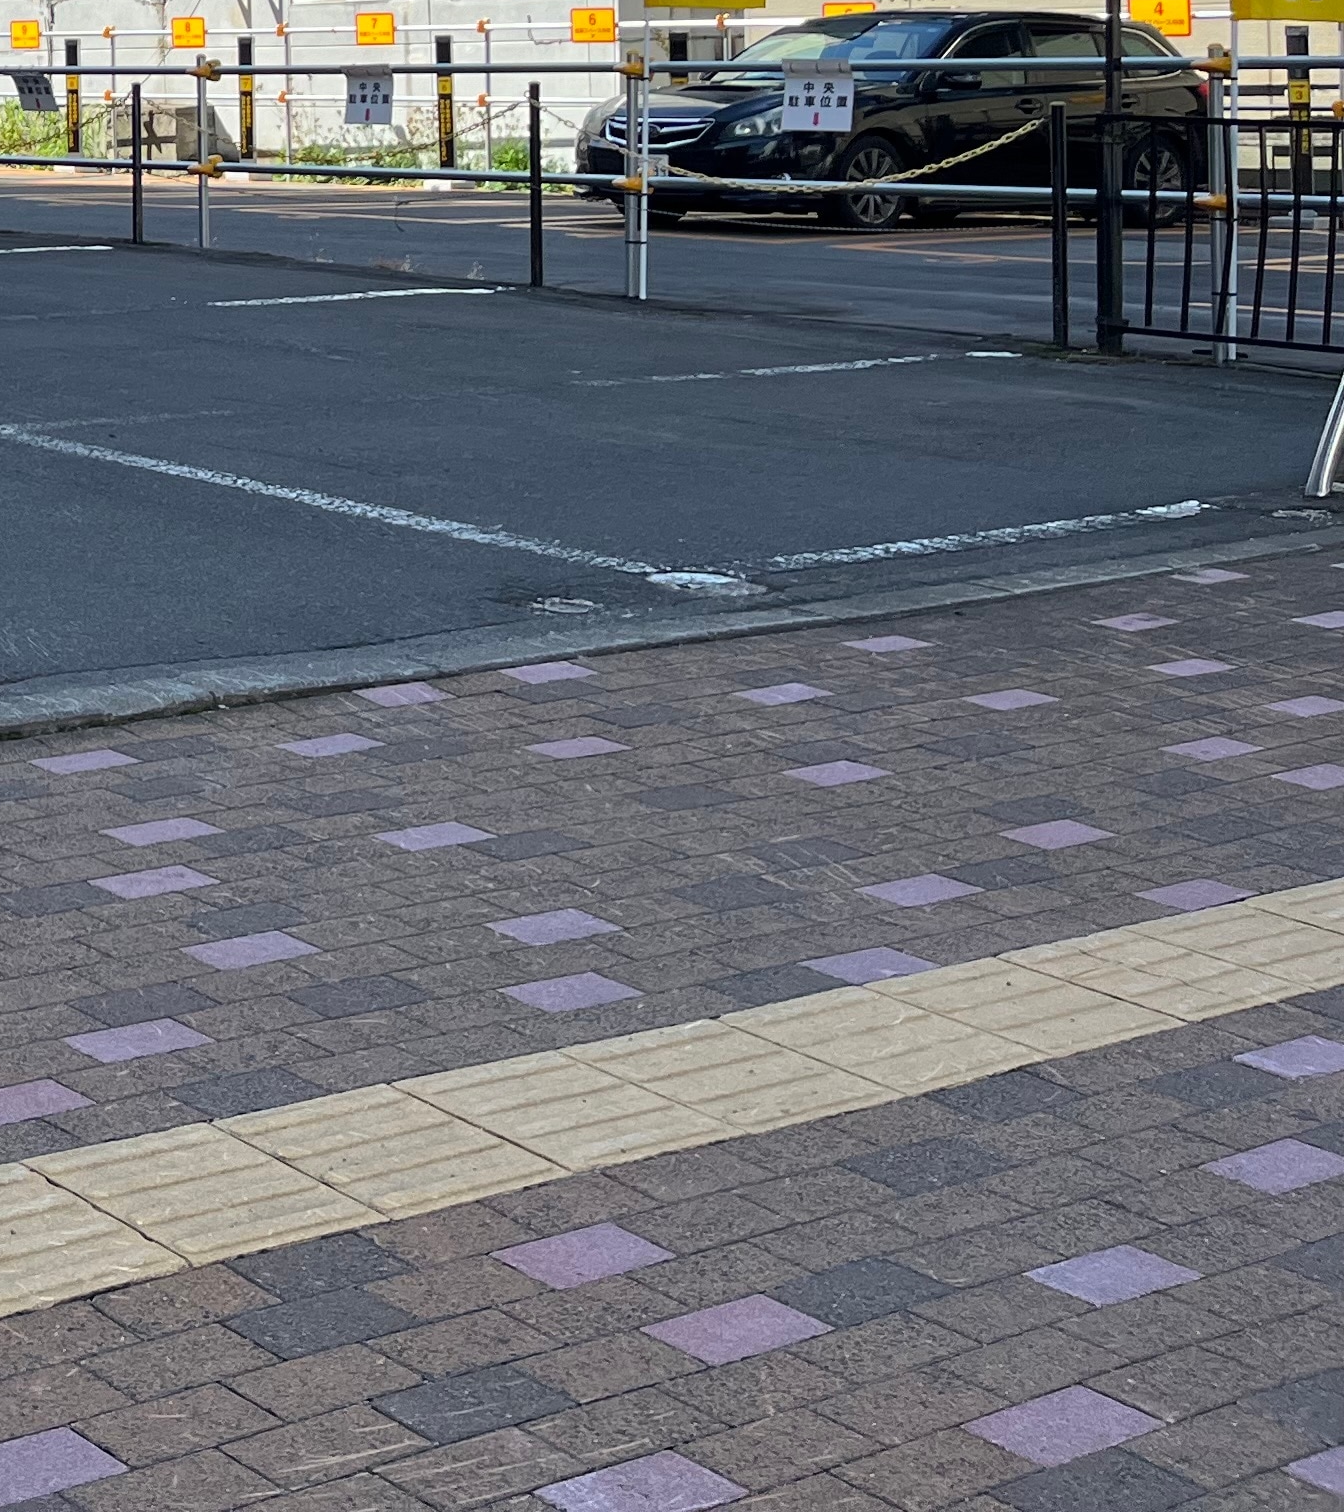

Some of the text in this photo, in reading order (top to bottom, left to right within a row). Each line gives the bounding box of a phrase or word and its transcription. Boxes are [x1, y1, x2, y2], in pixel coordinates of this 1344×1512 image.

[1154, 1, 1164, 16] 4
[371, 18, 378, 29] 7
[588, 13, 597, 26] 6
[22, 24, 28, 35] 9
[803, 81, 835, 93] 中央
[788, 95, 848, 108] 駐車位置
[1295, 90, 1303, 101] 3
